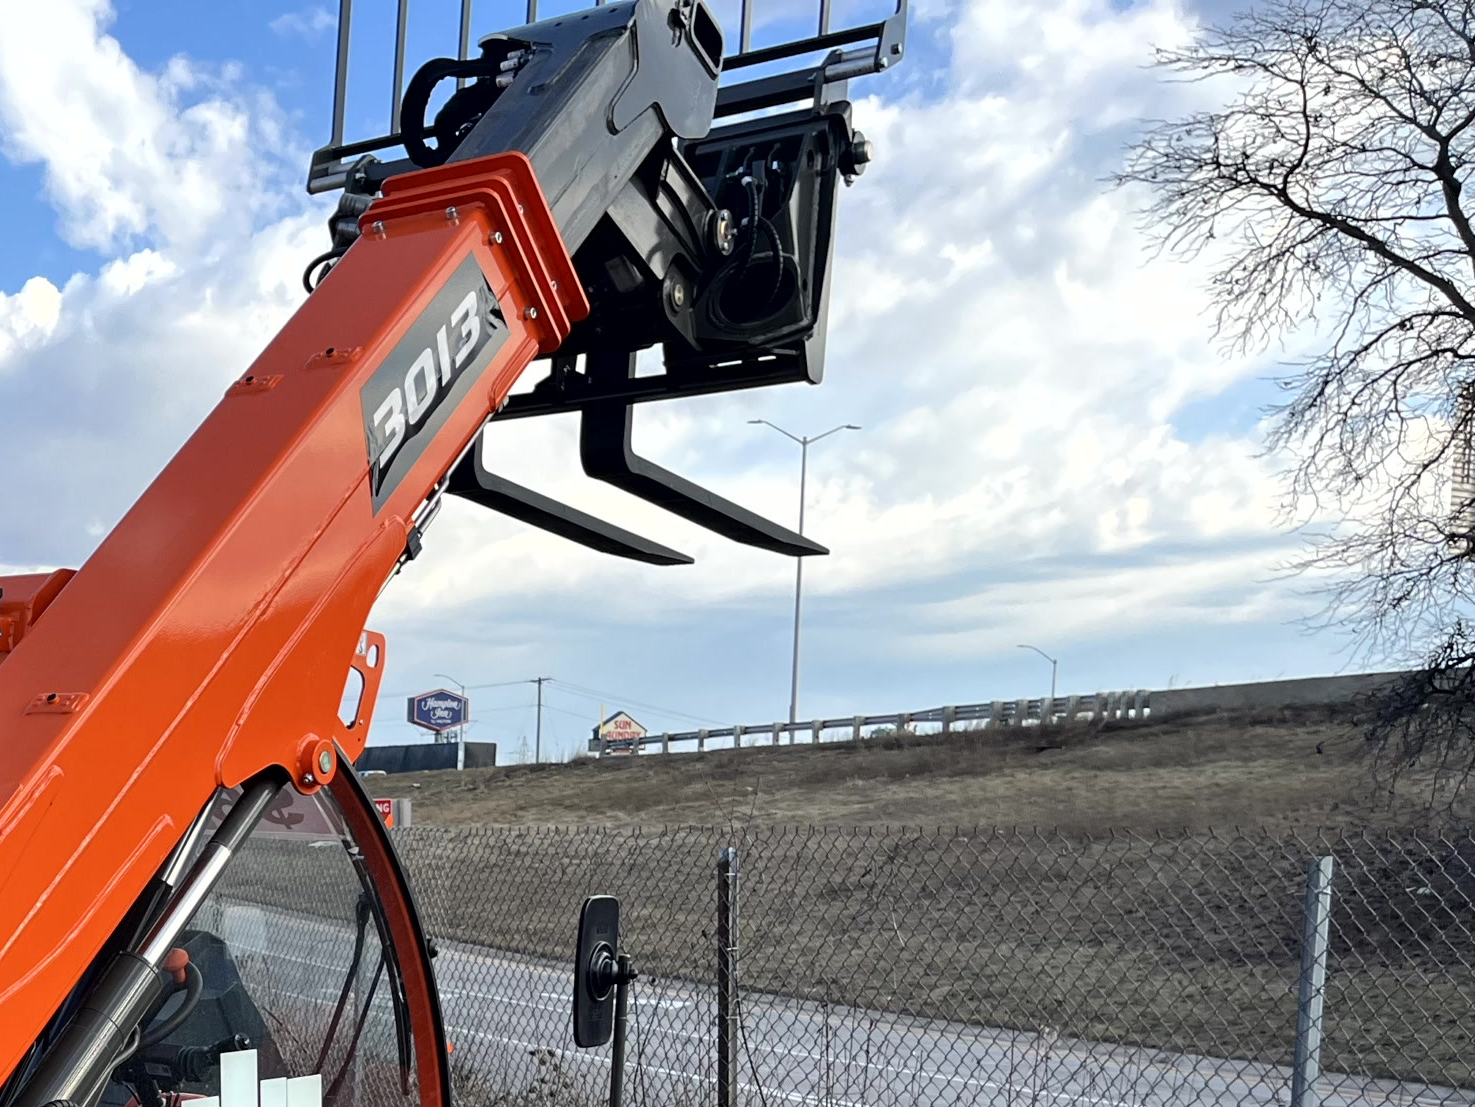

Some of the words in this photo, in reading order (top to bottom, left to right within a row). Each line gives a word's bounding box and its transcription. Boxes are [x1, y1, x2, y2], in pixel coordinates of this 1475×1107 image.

[373, 291, 481, 469] 3013
[421, 698, 462, 711] Hampton
[430, 708, 453, 719] Inn
[614, 720, 632, 730] SUN
[375, 802, 390, 813] NG
